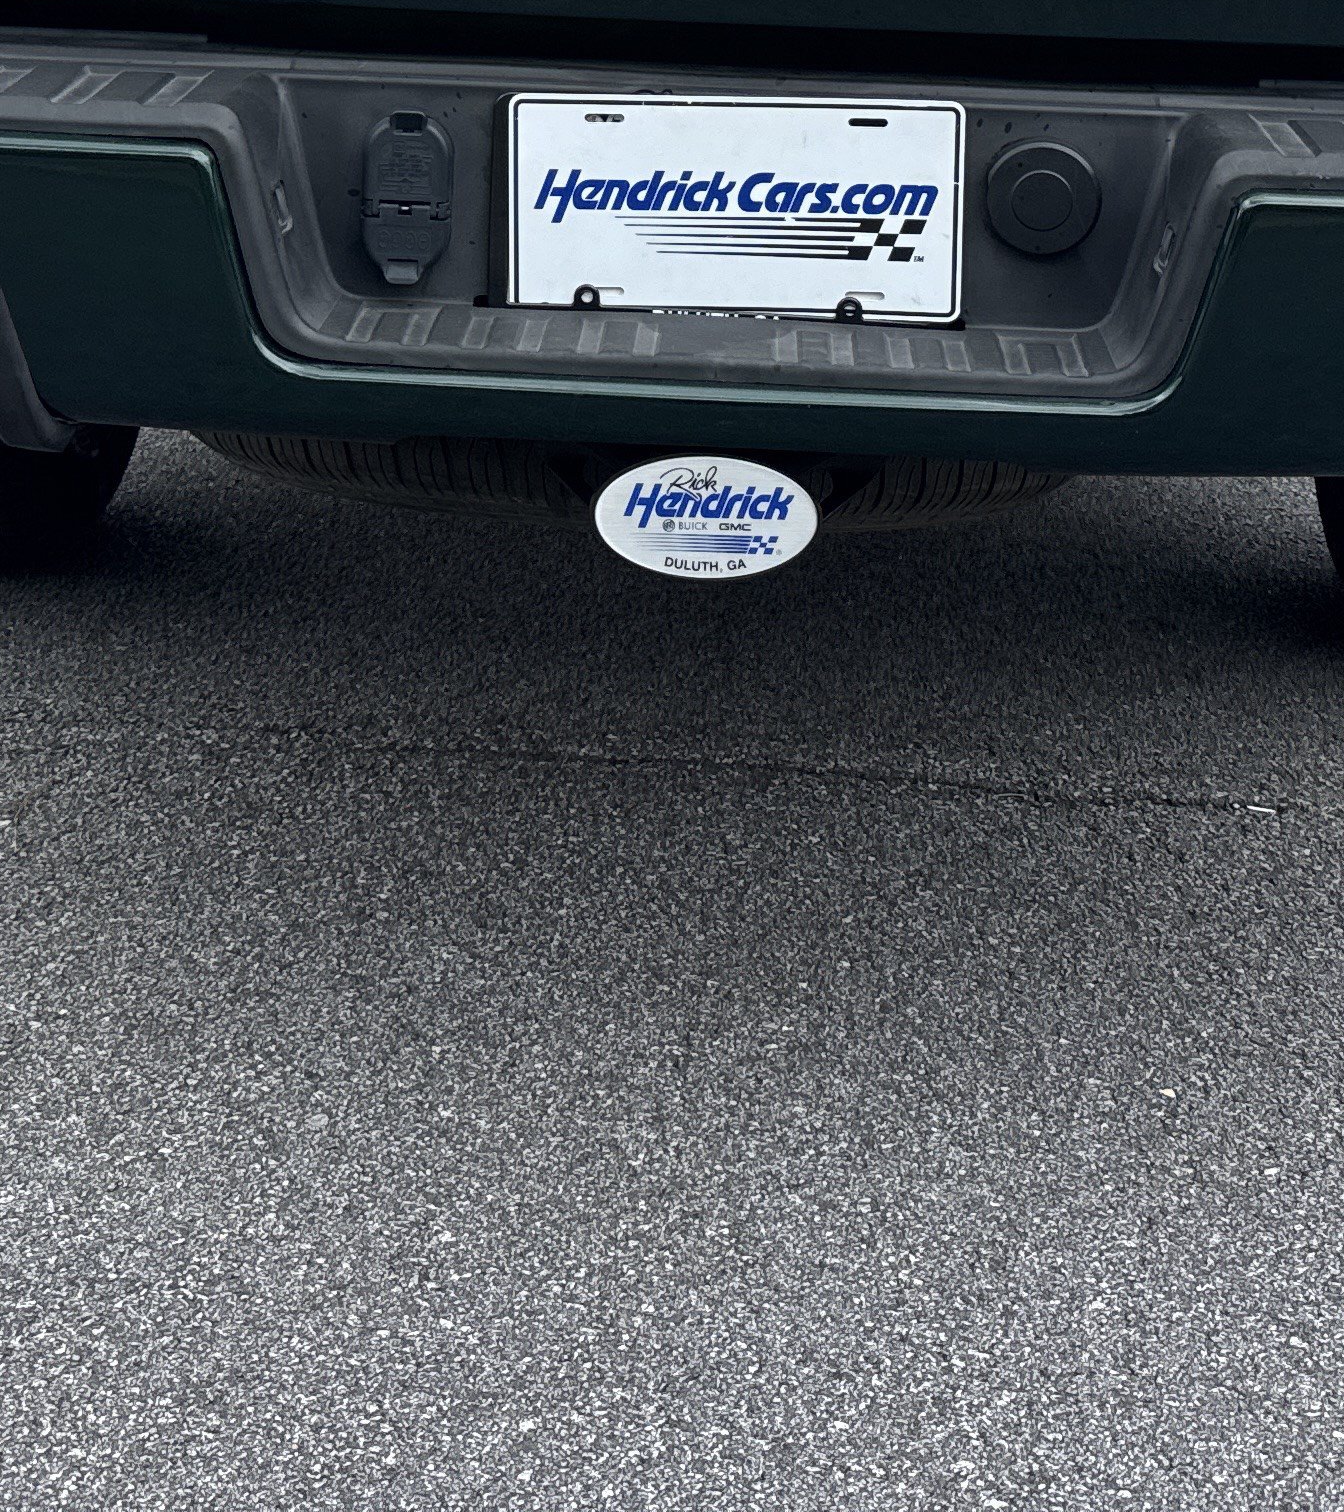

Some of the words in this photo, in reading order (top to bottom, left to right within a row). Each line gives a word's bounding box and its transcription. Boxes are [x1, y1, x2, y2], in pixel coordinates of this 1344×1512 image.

[660, 466, 718, 501] Rick
[623, 483, 795, 528] Hendrick
[678, 521, 708, 531] BUICK
[719, 523, 752, 531] GMC
[664, 557, 723, 573] DULUTH,
[727, 560, 747, 570] GA
